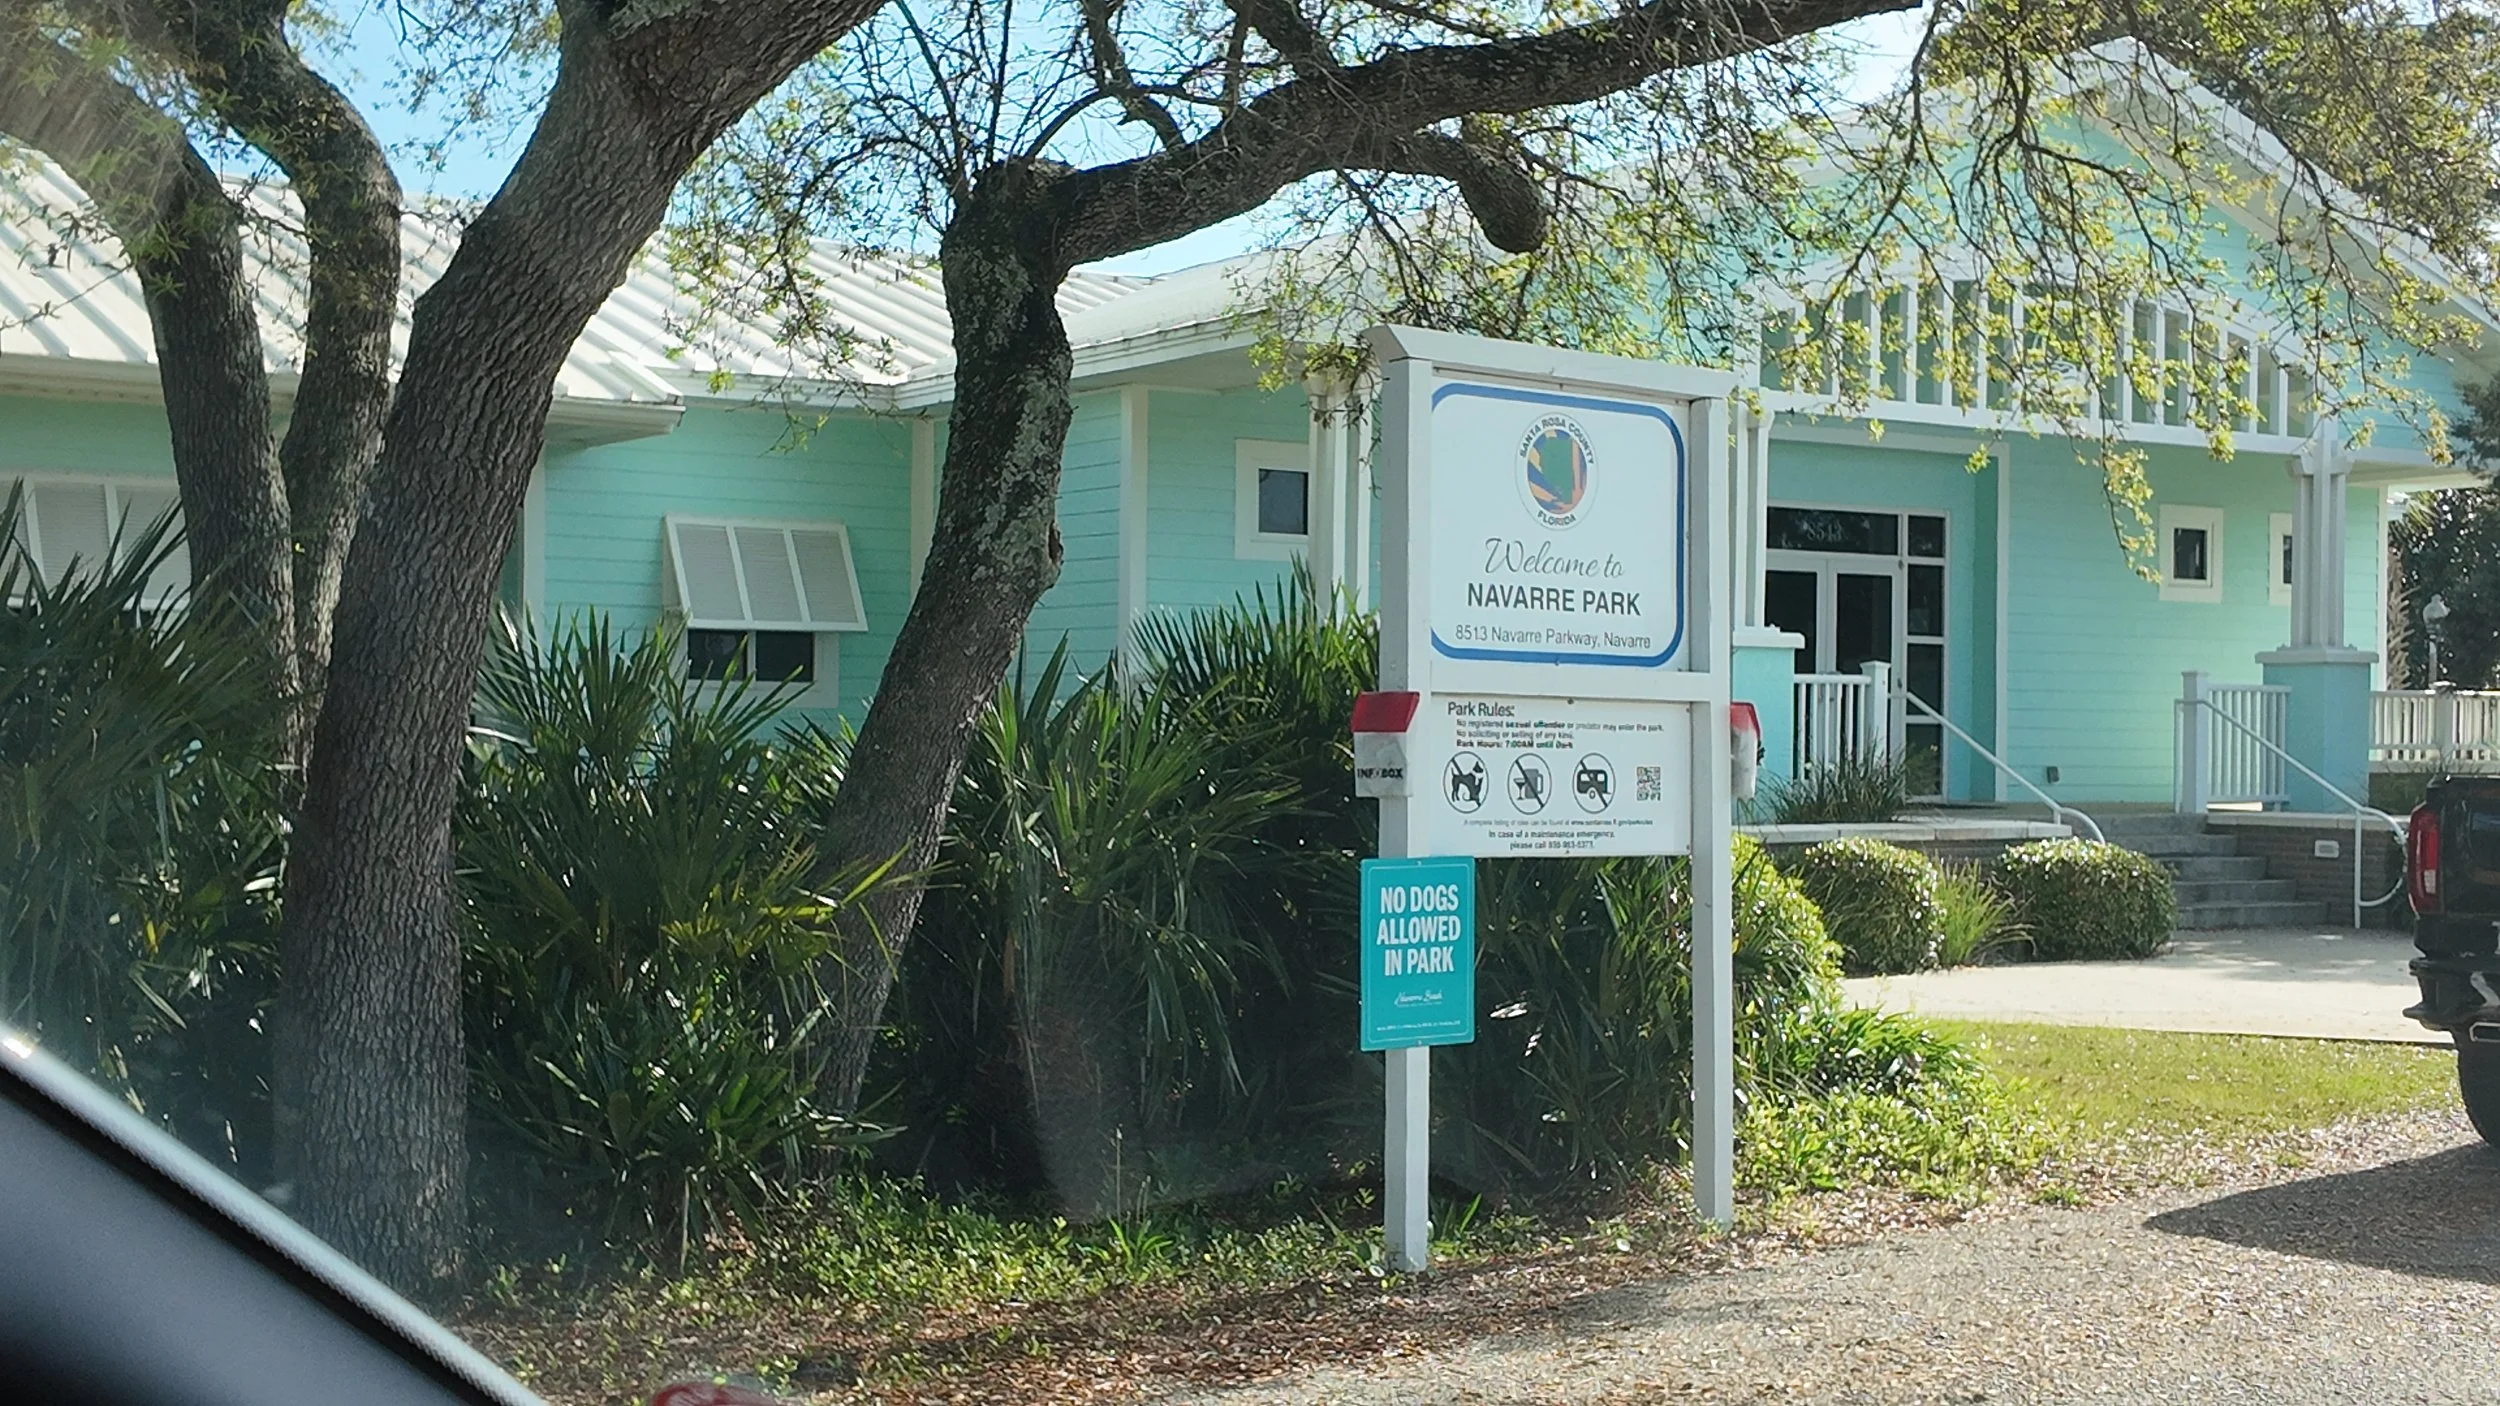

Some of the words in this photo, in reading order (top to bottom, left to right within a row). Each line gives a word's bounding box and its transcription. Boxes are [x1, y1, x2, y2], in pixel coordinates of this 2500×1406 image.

[1520, 424, 1541, 458] SANTA
[1541, 417, 1566, 428] ROSA
[1568, 423, 1594, 464] COUNTY
[1537, 510, 1576, 526] FLORIDA
[1485, 537, 1597, 576] Welcome
[1602, 553, 1625, 577] to
[1467, 583, 1575, 612] NAVARRE
[1583, 591, 1641, 616] PARK
[1455, 624, 1487, 641] 8513
[1492, 626, 1542, 644] Navarre
[1546, 628, 1601, 648] Parkway,
[1604, 632, 1650, 648] Navarre
[1448, 701, 1476, 716] Park
[1478, 702, 1515, 717] Rules:
[1457, 719, 1466, 727] No
[1468, 720, 1503, 729] registered
[1505, 720, 1531, 728] sexual
[1533, 720, 1565, 729] offender
[1457, 729, 1466, 737] No
[1468, 729, 1500, 739] soliciting
[1511, 730, 1533, 740] selling
[1381, 768, 1404, 779] BOX
[1488, 830, 1496, 838] In
[1515, 830, 1523, 838] of
[1510, 841, 1533, 850] please
[1534, 841, 1546, 849] call
[1380, 886, 1406, 914] NO
[1410, 884, 1459, 912] DOGS
[1376, 915, 1461, 945] ALLOWED
[1384, 949, 1402, 976] IN
[1407, 946, 1454, 975] PARK
